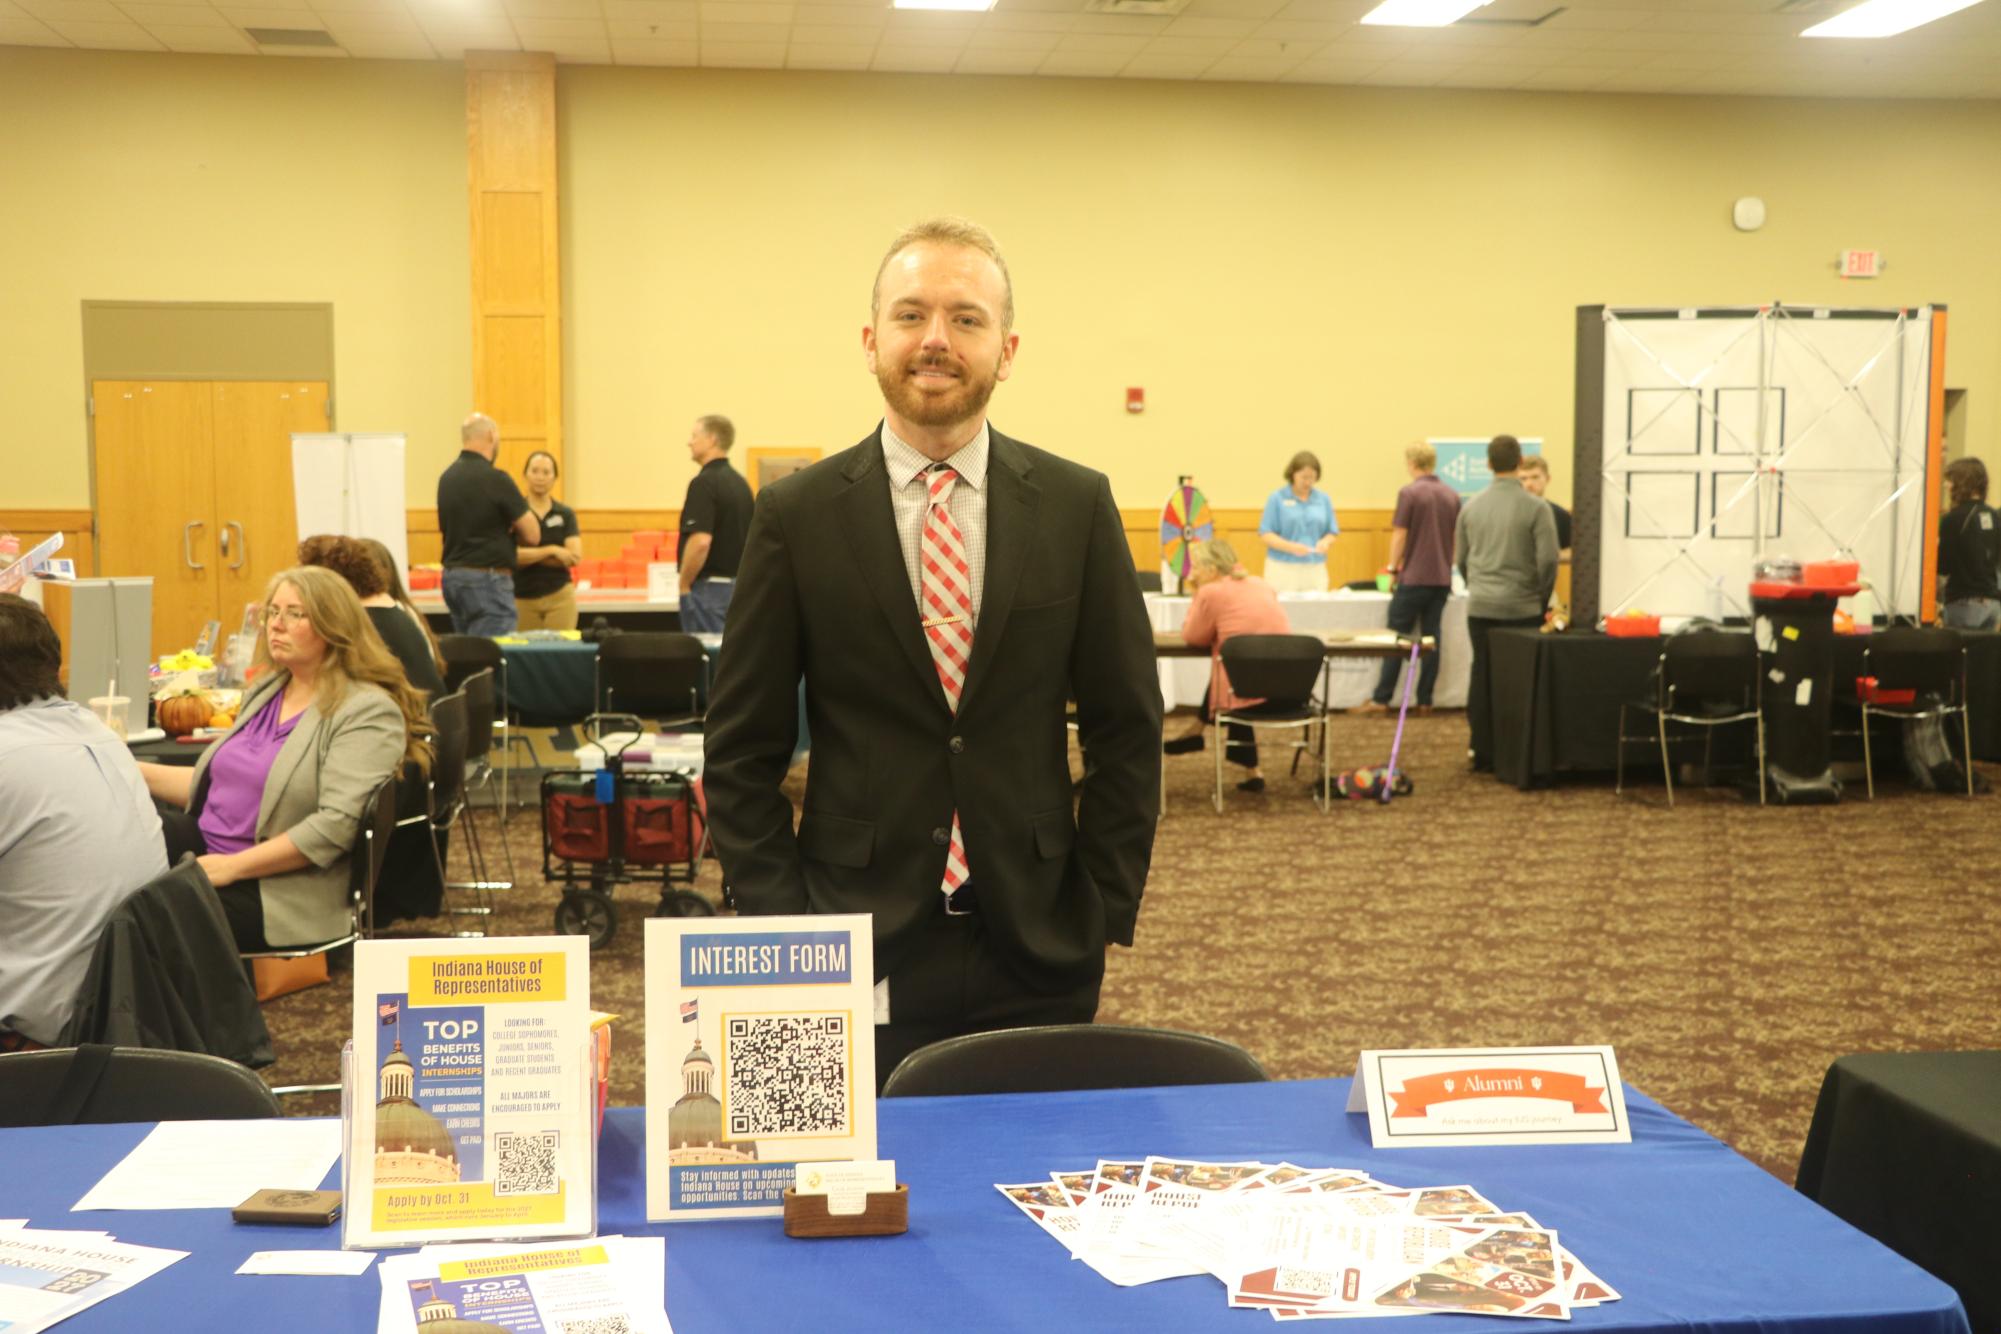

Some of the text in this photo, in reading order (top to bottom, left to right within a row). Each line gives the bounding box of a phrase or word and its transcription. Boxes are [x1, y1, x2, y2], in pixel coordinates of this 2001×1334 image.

[1848, 251, 1874, 272] EXIT
[691, 943, 846, 975] INTEREST FORM
[432, 958, 543, 976] Indiana House of
[434, 977, 542, 996] Representatives
[504, 1017, 531, 1028] LOOKING
[423, 1019, 479, 1040] TOP
[493, 1030, 516, 1040] COLLEGE
[423, 1043, 481, 1055] BENEFITS
[421, 1054, 483, 1066] OF HOUSE
[495, 1055, 525, 1064] GRADUATE
[421, 1067, 482, 1077] INTERNSHIPS
[491, 1065, 562, 1077] AND RECENT GRADUATES
[1463, 1074, 1524, 1092] Alumni
[419, 1086, 482, 1098] APPLY FOR SCHOLARSHIPS
[500, 1090, 551, 1101] ALL MAJORS ARE
[432, 1103, 446, 1113] MAKE
[491, 1102, 561, 1113] ENCOURAGED TO APPLY
[681, 1168, 795, 1182] Stay informed with updates
[681, 1181, 713, 1192] Indiana
[715, 1180, 740, 1191] House
[743, 1181, 753, 1191] on
[387, 1195, 418, 1208] Apply
[420, 1194, 432, 1207] by
[459, 1192, 469, 1204] 31
[681, 1191, 740, 1204] opportunities.
[743, 1190, 763, 1201] Scan
[765, 1189, 779, 1200] the
[71, 1250, 140, 1264] HOUSE
[464, 1249, 581, 1269] Indiana House of
[467, 1258, 582, 1275] Representatives
[460, 1279, 521, 1293] TOP
[462, 1292, 530, 1304] OF HOUSE
[463, 1287, 527, 1299] BENEFITS
